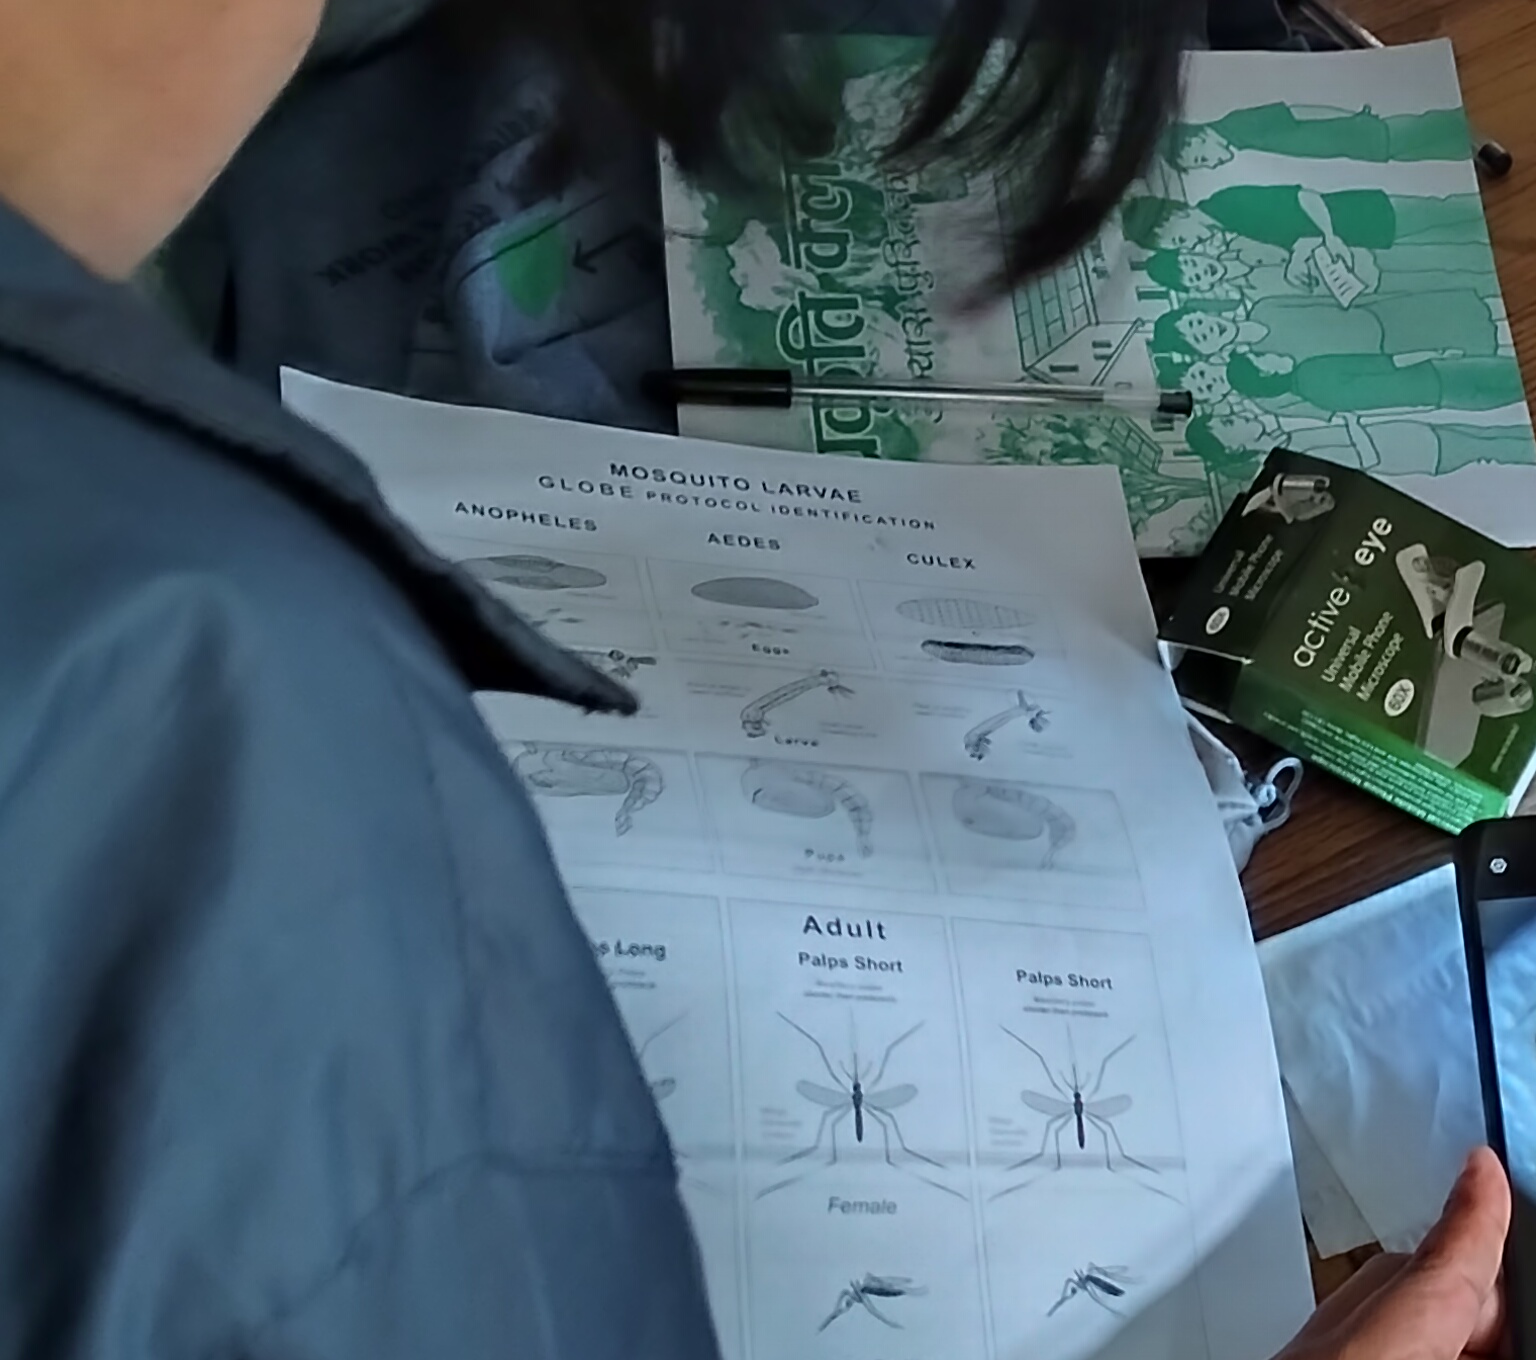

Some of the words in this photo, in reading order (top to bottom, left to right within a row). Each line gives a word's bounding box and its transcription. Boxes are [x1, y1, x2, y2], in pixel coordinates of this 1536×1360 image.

[609, 462, 750, 492] MOSQUITO
[762, 480, 863, 505] LARVAE
[454, 501, 598, 532] ANOPHELES
[538, 474, 635, 499] GLOBE
[646, 490, 761, 513] PROTOCOL
[771, 505, 936, 531] IDENTIFICATION
[707, 532, 781, 551] AEDES
[906, 552, 977, 570] CULEX
[1293, 587, 1350, 668] active
[1354, 517, 1393, 566] eye
[1321, 625, 1362, 683] Universal
[1338, 648, 1372, 693] Mobile
[1362, 611, 1394, 650] Phone
[1356, 632, 1405, 702] Microscope
[802, 915, 887, 940] Adult
[614, 940, 667, 962] Long
[798, 951, 849, 971] Palps
[855, 955, 904, 973] Short
[1016, 969, 1063, 988] Palps
[1067, 973, 1113, 990] Short
[828, 1196, 898, 1215] Female
